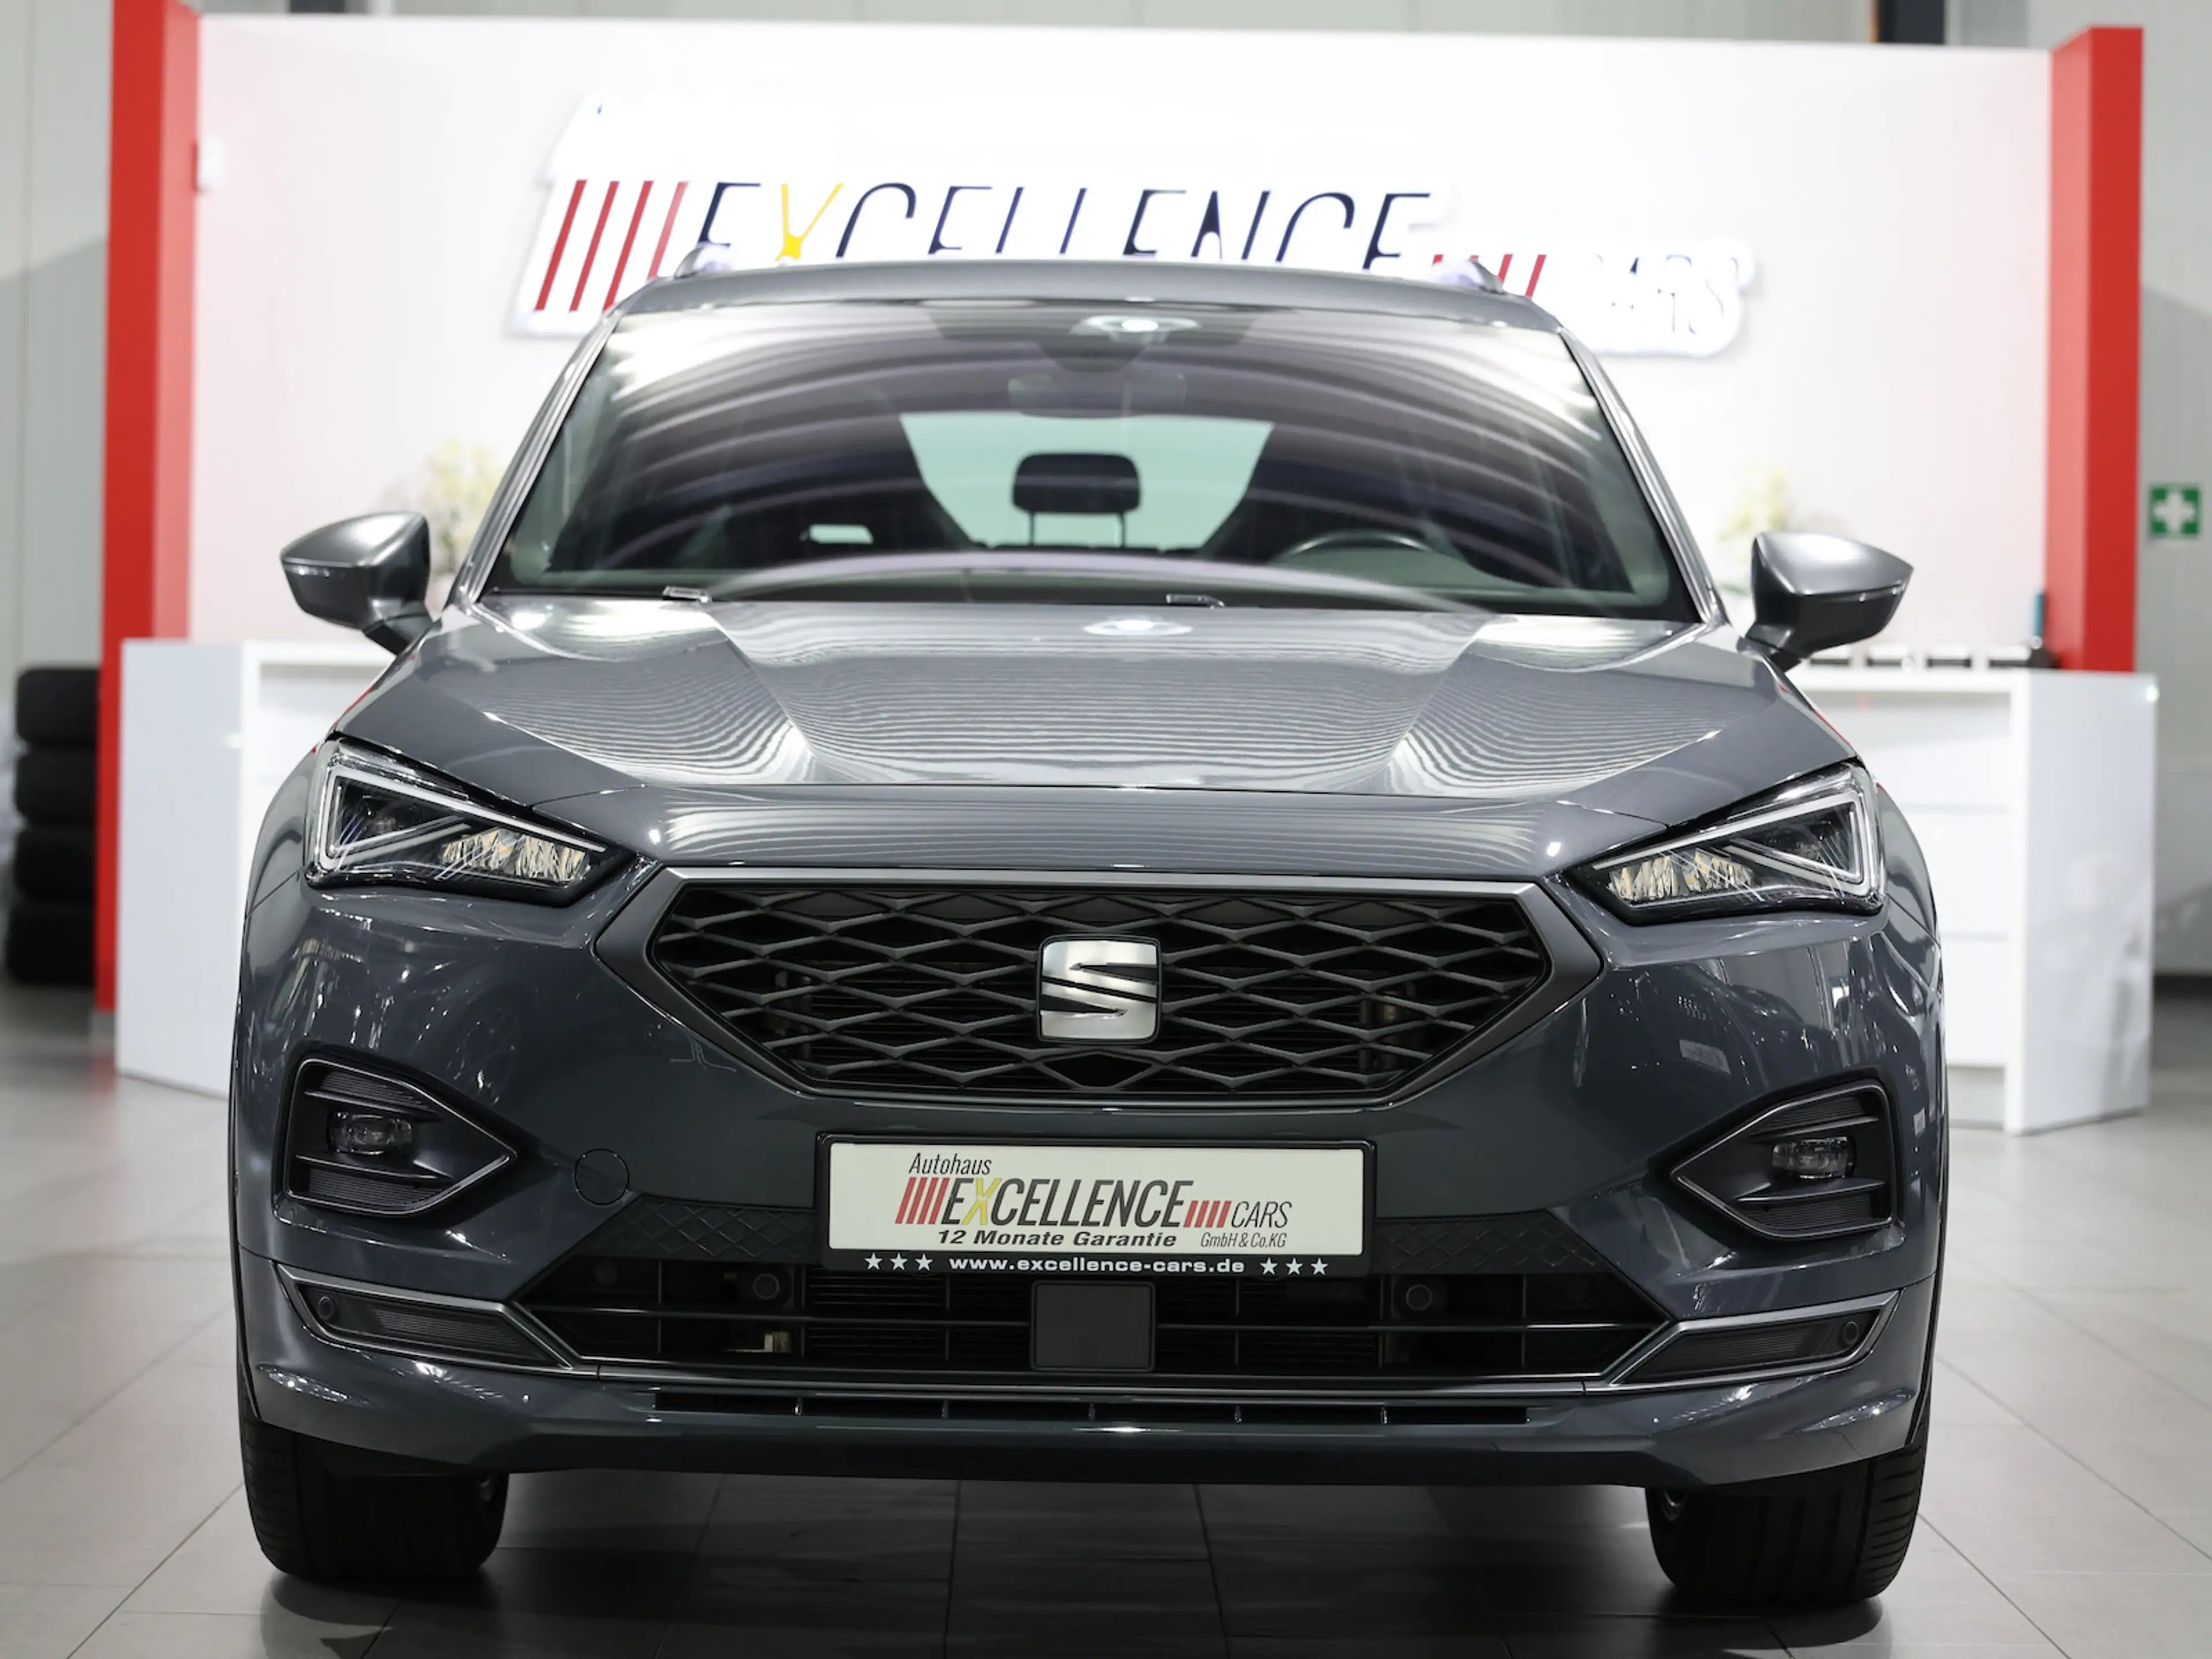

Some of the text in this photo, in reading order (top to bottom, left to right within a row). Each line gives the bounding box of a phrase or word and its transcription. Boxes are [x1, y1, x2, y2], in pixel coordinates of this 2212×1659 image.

[909, 1153, 992, 1175] Autohaus
[941, 1177, 1293, 1229] EXCELLENCE CARS
[938, 1229, 1176, 1248] 12 Monate Garantie
[1200, 1232, 1237, 1247] GmbH
[949, 1257, 1245, 1272] www.excellence-cars.de
